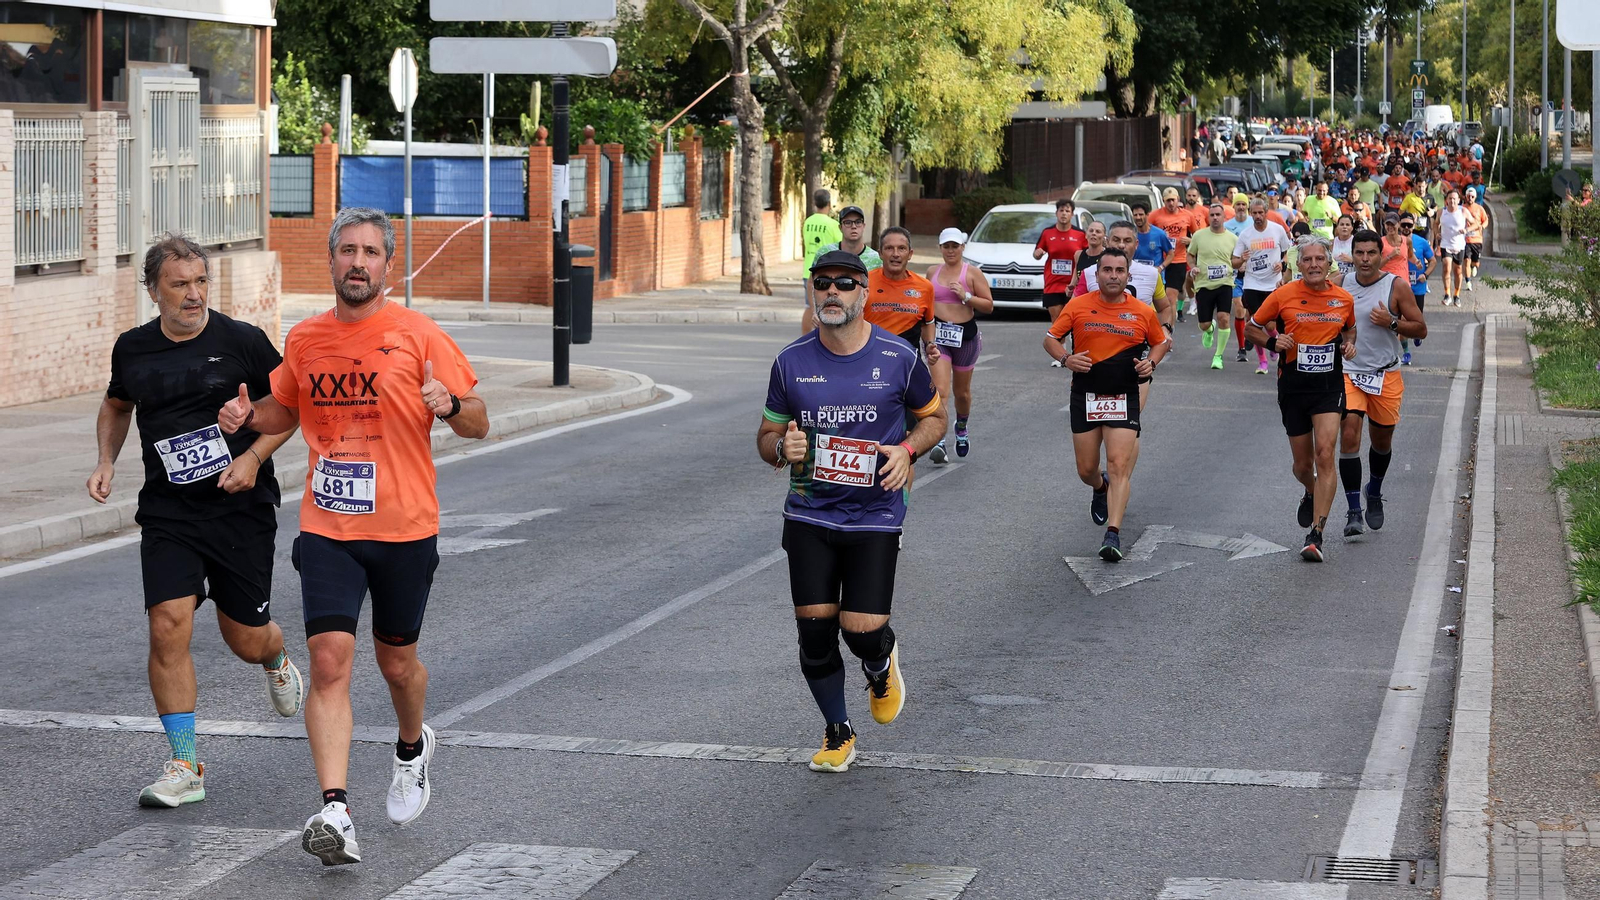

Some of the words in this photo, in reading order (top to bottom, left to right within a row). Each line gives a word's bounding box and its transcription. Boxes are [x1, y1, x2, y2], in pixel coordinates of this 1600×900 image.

[806, 224, 827, 233] STAFF
[997, 279, 1015, 288] 9393
[939, 330, 957, 340] 1014
[1306, 354, 1327, 364] 989
[1355, 373, 1375, 385] 657
[308, 372, 379, 399] XXIX
[842, 403, 877, 412] MARATÓN
[1096, 401, 1117, 411] 463
[801, 410, 815, 422] EL
[817, 410, 878, 423] PUERTO
[801, 420, 816, 428] BASE
[176, 444, 213, 468] 932
[829, 452, 861, 471] 144
[322, 477, 354, 497] 681
